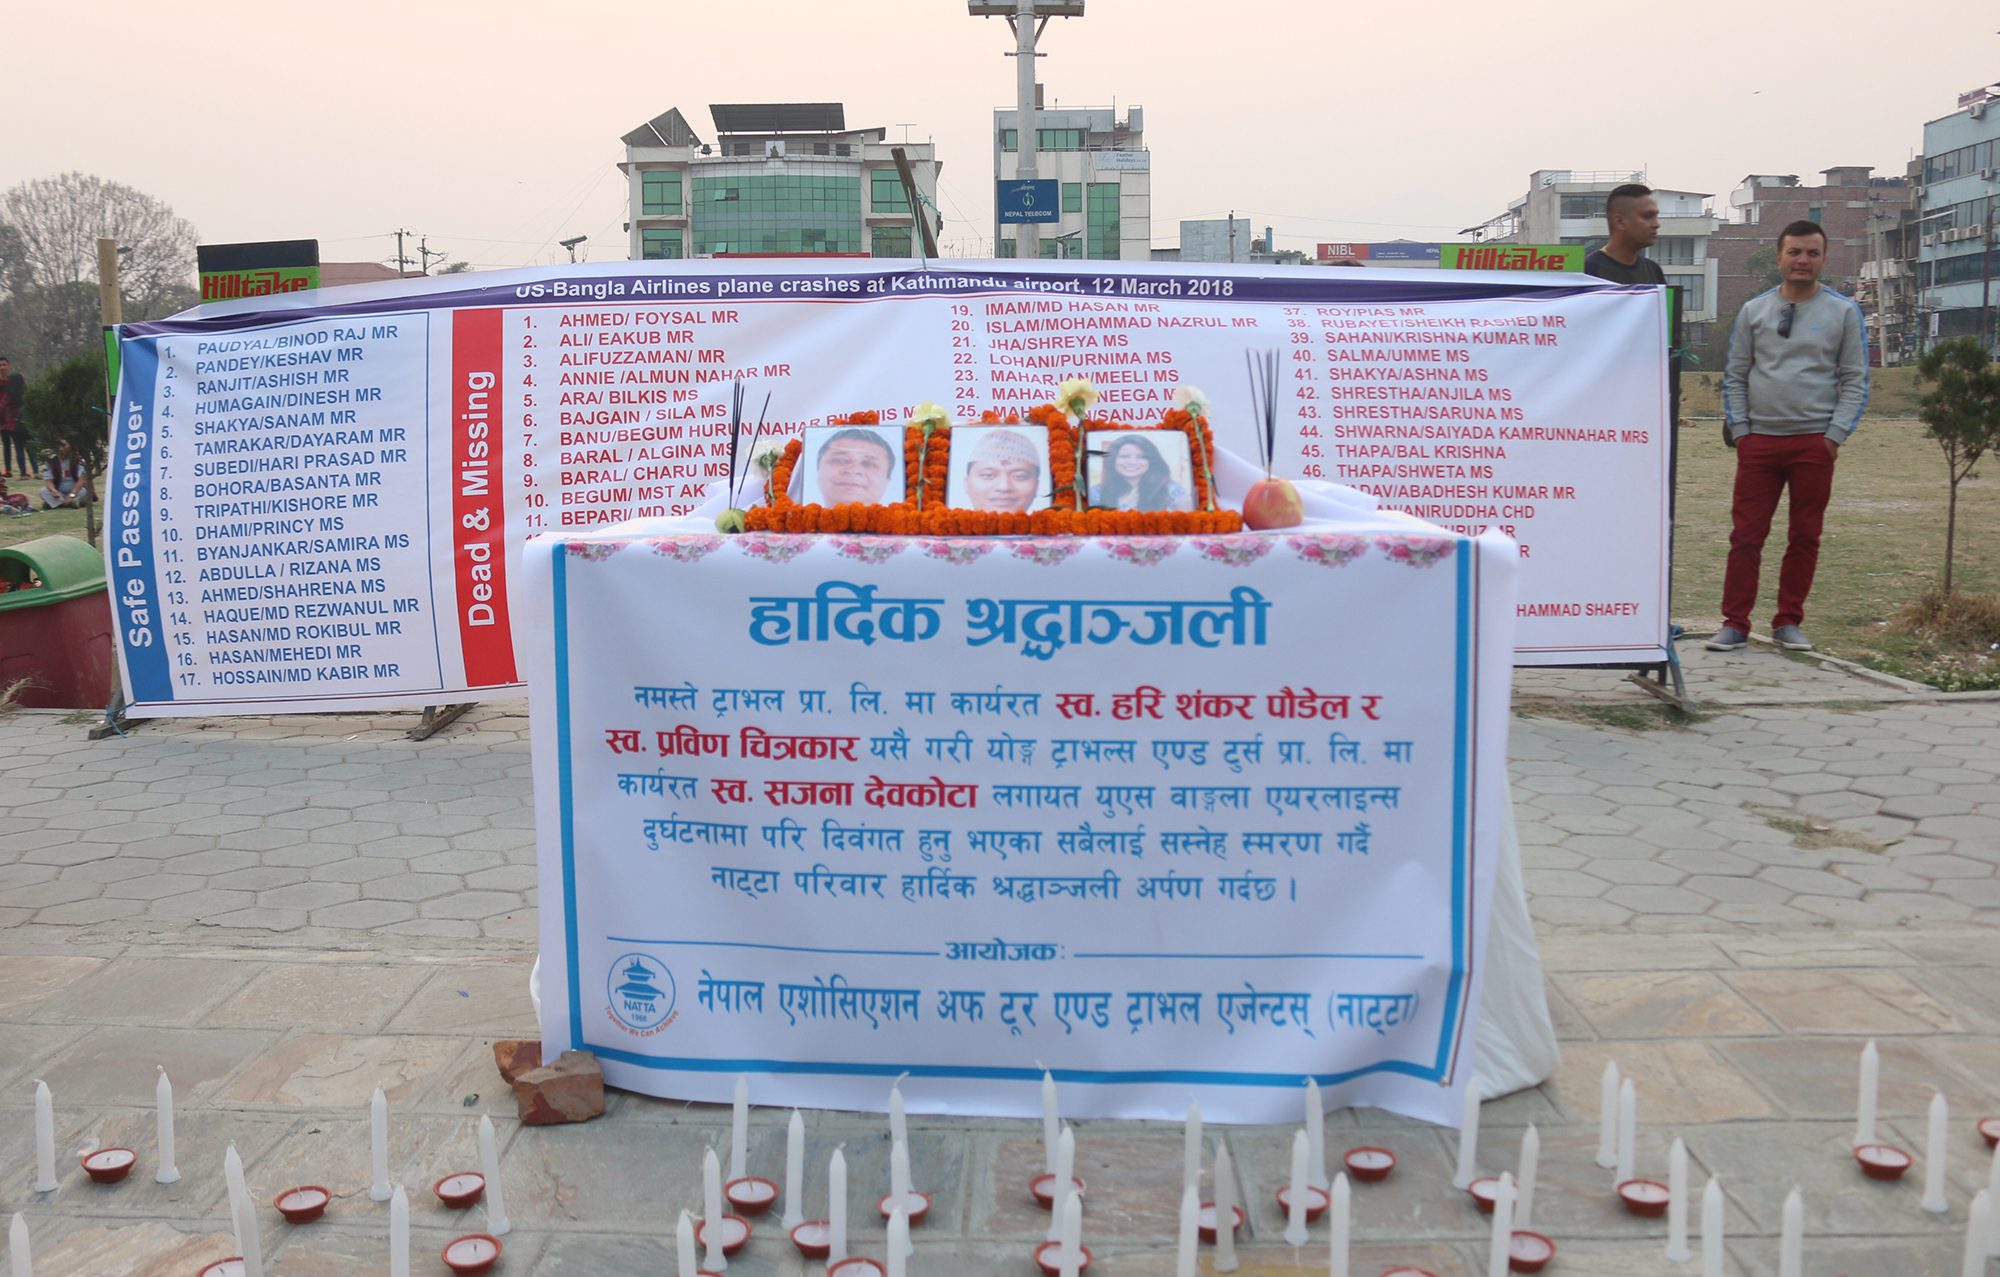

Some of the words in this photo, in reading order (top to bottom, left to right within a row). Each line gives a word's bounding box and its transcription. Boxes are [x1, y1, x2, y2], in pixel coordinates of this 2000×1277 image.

[1327, 245, 1355, 256] NIBL
[1456, 247, 1566, 270] Hilltake
[202, 272, 309, 299] Hilltake
[516, 280, 626, 299] US-Bangla
[631, 279, 710, 295] Airlines
[718, 278, 772, 297] plane
[780, 276, 860, 293] crashes
[867, 279, 886, 293] at
[891, 276, 1007, 291] Kathmandu
[1014, 280, 1086, 294] airport,
[1092, 278, 1115, 294] 12
[1121, 278, 1182, 295] March
[1188, 280, 1233, 296] 2018
[524, 316, 537, 328] 1.
[560, 313, 629, 327] AHMED/
[636, 312, 706, 325] FOYSAL
[712, 311, 738, 323] MR
[952, 320, 974, 331] 20.
[987, 317, 1152, 333] ISLAM/MOHAMMAD
[1158, 317, 1227, 327] NAZRUL
[1232, 318, 1257, 327] MR
[166, 347, 175, 358] 1.
[198, 331, 328, 355] PAUDYAL/BINOD
[334, 328, 365, 341] RAJ
[372, 326, 397, 339] MR
[1291, 332, 1313, 343] 39.
[1325, 332, 1468, 343] SAHANI/KRISHNA
[1473, 333, 1529, 345] KUMAR
[1534, 334, 1557, 346] MR
[524, 355, 536, 367] 3.
[560, 350, 692, 366] ALIFUZZAMAN/
[698, 350, 725, 363] MR
[954, 353, 977, 364] 22.
[990, 352, 1142, 368] LOHANI/PURNIMA
[1147, 351, 1172, 364] MS
[164, 386, 175, 398] 3.
[198, 371, 317, 395] RANJIT/ASHISH
[324, 369, 349, 383] MR
[1295, 368, 1317, 380] 41.
[1330, 368, 1460, 381] SHAKYA/ASHNA
[1465, 369, 1488, 381] MS
[524, 394, 537, 407] 5.
[560, 391, 603, 405] ARA/
[610, 390, 667, 404] BILKIS
[673, 390, 698, 402] MS
[162, 426, 172, 438] 5.
[195, 412, 324, 435] SHAKYA/SANAM
[331, 410, 356, 424] MR
[1298, 406, 1321, 419] 43.
[1333, 406, 1496, 419] SHRESTHA/SARUNA
[1501, 408, 1523, 420] MS
[462, 371, 495, 496] Missing
[1300, 425, 1323, 438] 44.
[1335, 425, 1495, 439] SHWARNA/SAIYADA
[1500, 427, 1617, 442] KAMRUNNAHAR
[1621, 430, 1648, 444] MRS
[161, 467, 172, 479] 7.
[194, 456, 298, 476] SUBEDI/HARI
[305, 451, 374, 468] PRASAD
[381, 449, 406, 463] MR
[118, 401, 147, 568] Passenger
[160, 508, 172, 521] 9.
[195, 495, 347, 518] TRIPATHI/KISHORE
[353, 493, 378, 507] MR
[462, 506, 490, 531] &
[164, 550, 183, 563] 11.
[197, 536, 380, 561] BYANJANKAR/SAMIRA
[385, 534, 409, 548] MS
[168, 591, 188, 604] 13.
[202, 581, 357, 603] AHMED/SHAHRENA
[361, 579, 385, 593] MS
[463, 542, 495, 627] Dead
[122, 578, 152, 648] Safe
[749, 579, 945, 646] हार्दिक
[174, 632, 194, 645] 15.
[207, 627, 290, 644] HASAN/MD
[296, 623, 371, 639] ROKIBUL
[376, 621, 401, 635] MR
[180, 673, 200, 685] 17.
[213, 668, 311, 684] HOSSAIN/MD
[317, 665, 369, 680] KABIR
[374, 664, 400, 678] MR
[634, 682, 698, 713] नमस्ते
[713, 689, 784, 718] ट्राभल
[800, 689, 831, 714] प्रा.
[849, 682, 887, 714] लि.
[906, 691, 935, 714] मा
[951, 684, 1041, 718] कार्यरत
[1056, 693, 1100, 720] स्व.
[1112, 685, 1165, 720] हरि
[1176, 689, 1256, 720] शंकर
[1267, 687, 1350, 720] पौडेल
[1361, 695, 1383, 720] र
[605, 728, 646, 755] स्व.
[657, 725, 729, 758] प्रविण
[741, 727, 860, 762] चित्रकार
[870, 727, 910, 761] यसै
[926, 731, 973, 762] गरी
[1051, 740, 1137, 769] ट्राभल्स
[1152, 741, 1209, 770] एण्ड
[1223, 733, 1263, 773] टुर्स
[1278, 741, 1311, 765] प्रा.
[1329, 732, 1365, 764] लि.
[1384, 741, 1413, 763] मा
[617, 768, 698, 800] कार्यरत
[712, 779, 752, 804] स्व.
[764, 780, 854, 807] सजना
[865, 775, 979, 808] देवकोटा
[993, 785, 1081, 809] लगायत
[1096, 786, 1155, 818] युएस
[1266, 787, 1401, 816] एयरलाइन्स
[643, 812, 748, 851] दुर्घटनामा
[762, 817, 806, 851] परि
[822, 818, 904, 853] दिवंगत
[919, 830, 952, 862] हुनु
[968, 830, 1042, 860] भएका
[1057, 821, 1146, 858] सबैलाई
[1160, 826, 1228, 860] सस्नेह
[1242, 832, 1322, 857] स्मरण
[794, 864, 887, 899] परिवार
[902, 866, 977, 902] हार्दिक
[1137, 870, 1203, 901] अर्पण
[1218, 870, 1276, 902] गर्दछ
[624, 1000, 656, 1013] NATTA
[698, 969, 765, 1014] नेपाल
[778, 974, 921, 1031] एशोसिएशन
[937, 989, 985, 1023] अफ
[999, 992, 1038, 1036] टूर
[1053, 992, 1112, 1035] एण्ड
[1127, 992, 1202, 1035] ट्राभल
